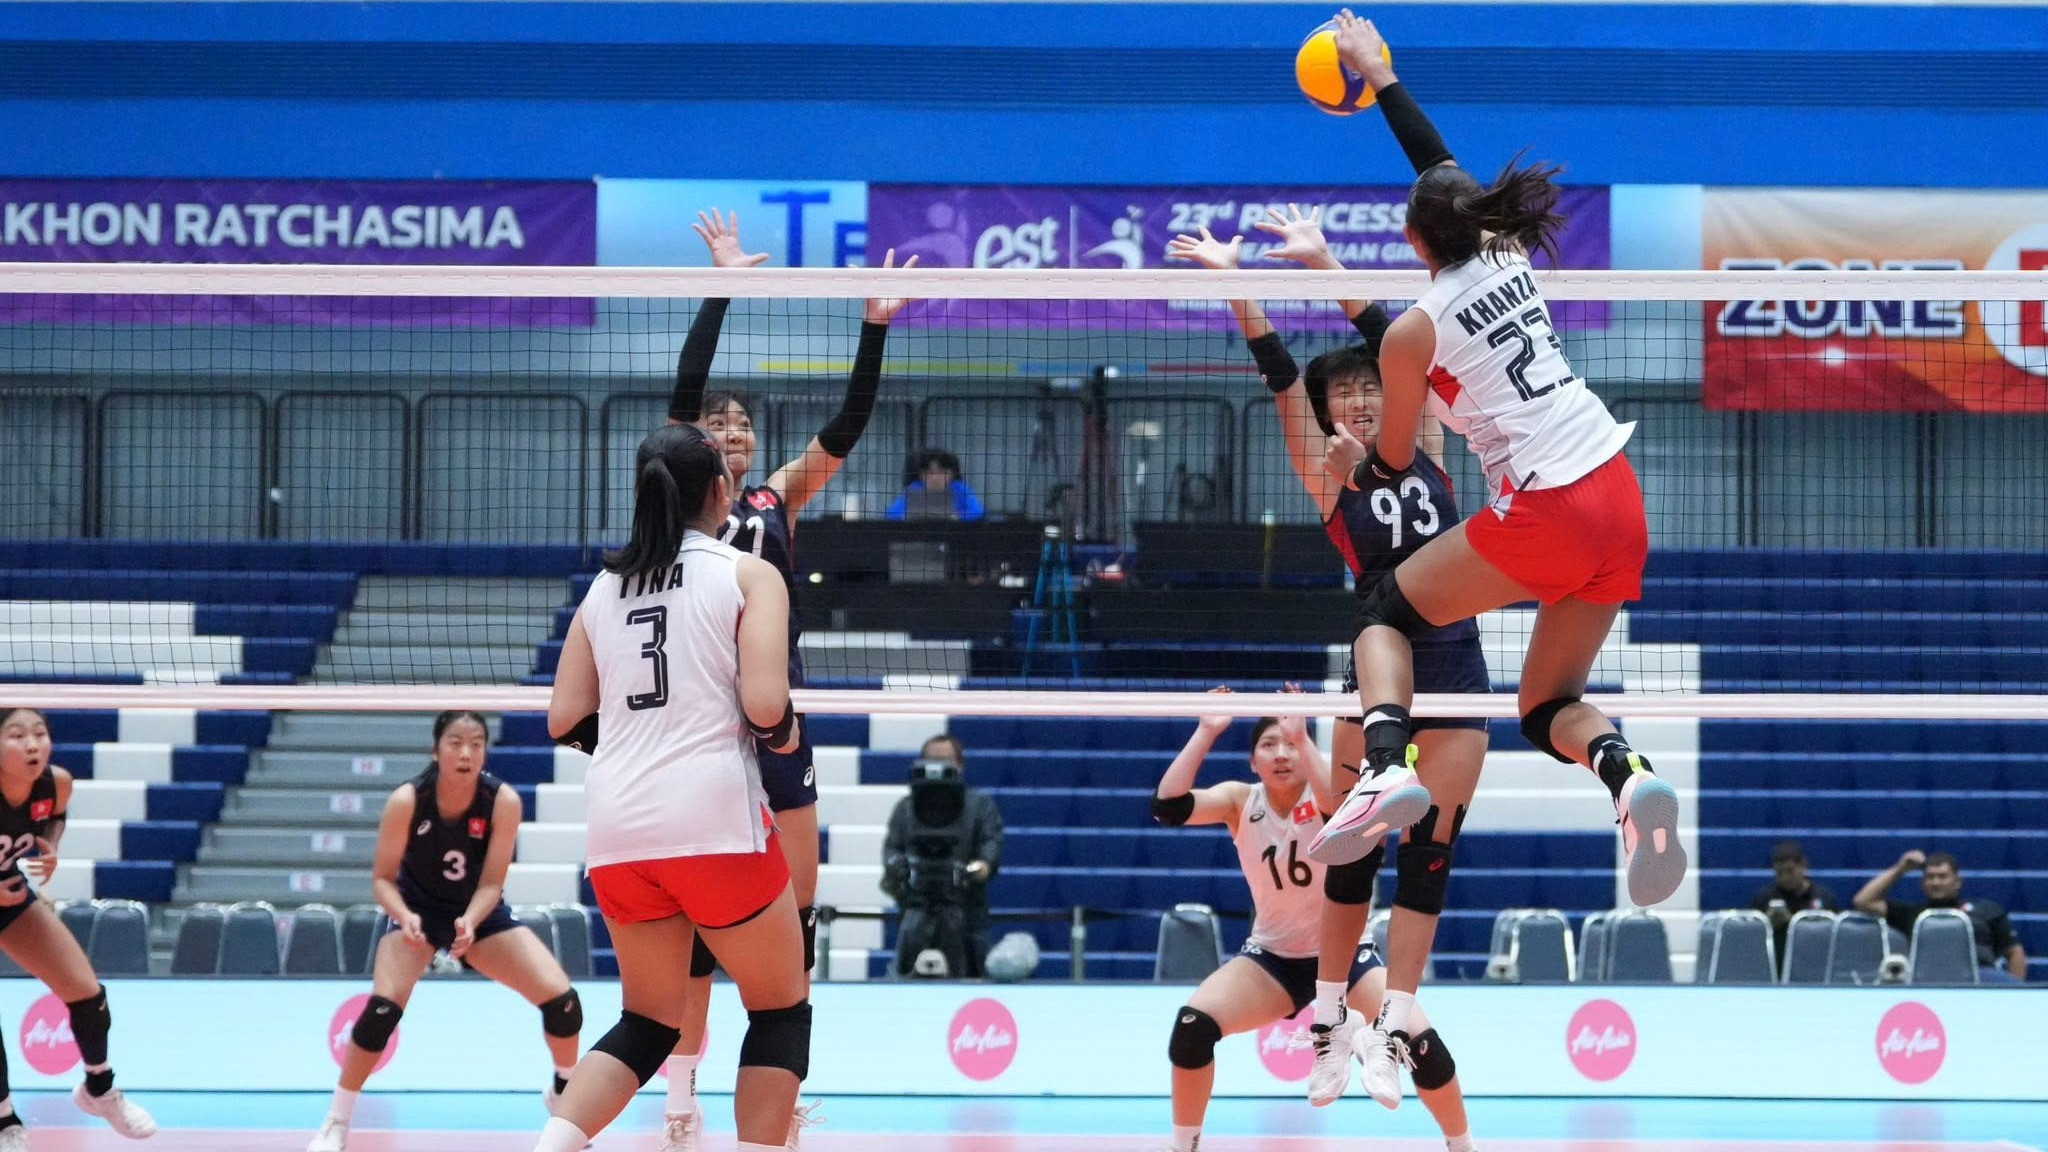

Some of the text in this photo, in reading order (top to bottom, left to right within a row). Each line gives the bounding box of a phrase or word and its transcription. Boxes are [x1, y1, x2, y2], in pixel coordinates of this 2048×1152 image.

[0, 201, 524, 249] KHON RATCHASIMA
[1455, 271, 1538, 336] KHANZA
[1719, 260, 1964, 337] ZONE
[1370, 476, 1439, 549] 93
[626, 605, 669, 711] 3
[442, 849, 466, 881] 3
[1261, 839, 1313, 890] 16
[24, 1018, 77, 1049] AirA
